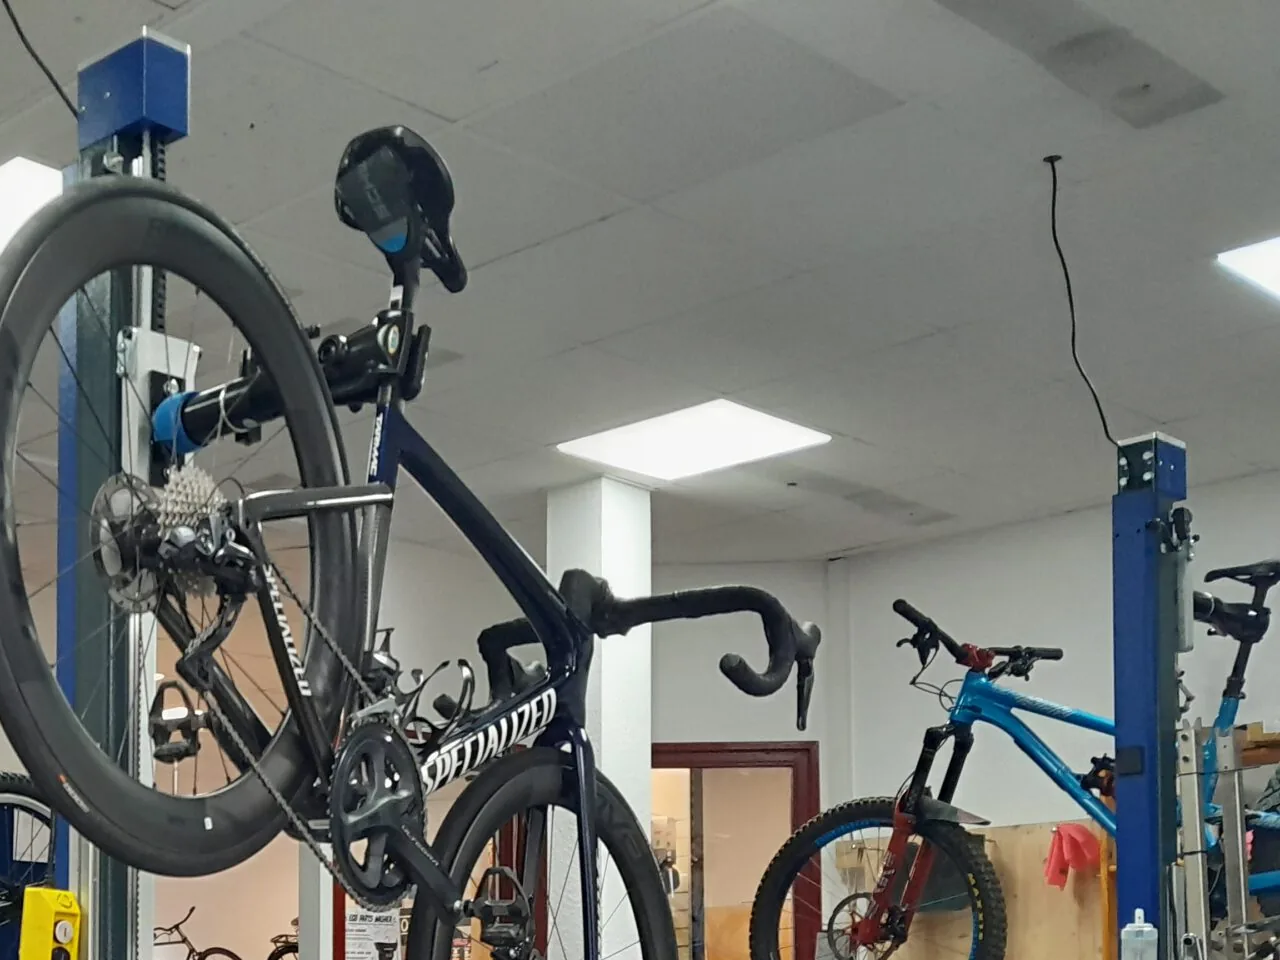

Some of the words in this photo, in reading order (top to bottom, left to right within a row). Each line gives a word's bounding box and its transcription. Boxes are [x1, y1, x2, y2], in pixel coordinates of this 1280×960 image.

[370, 412, 384, 477] TARMAC
[263, 563, 312, 697] SPECIALIZED
[421, 687, 558, 796] SPECIALIZED
